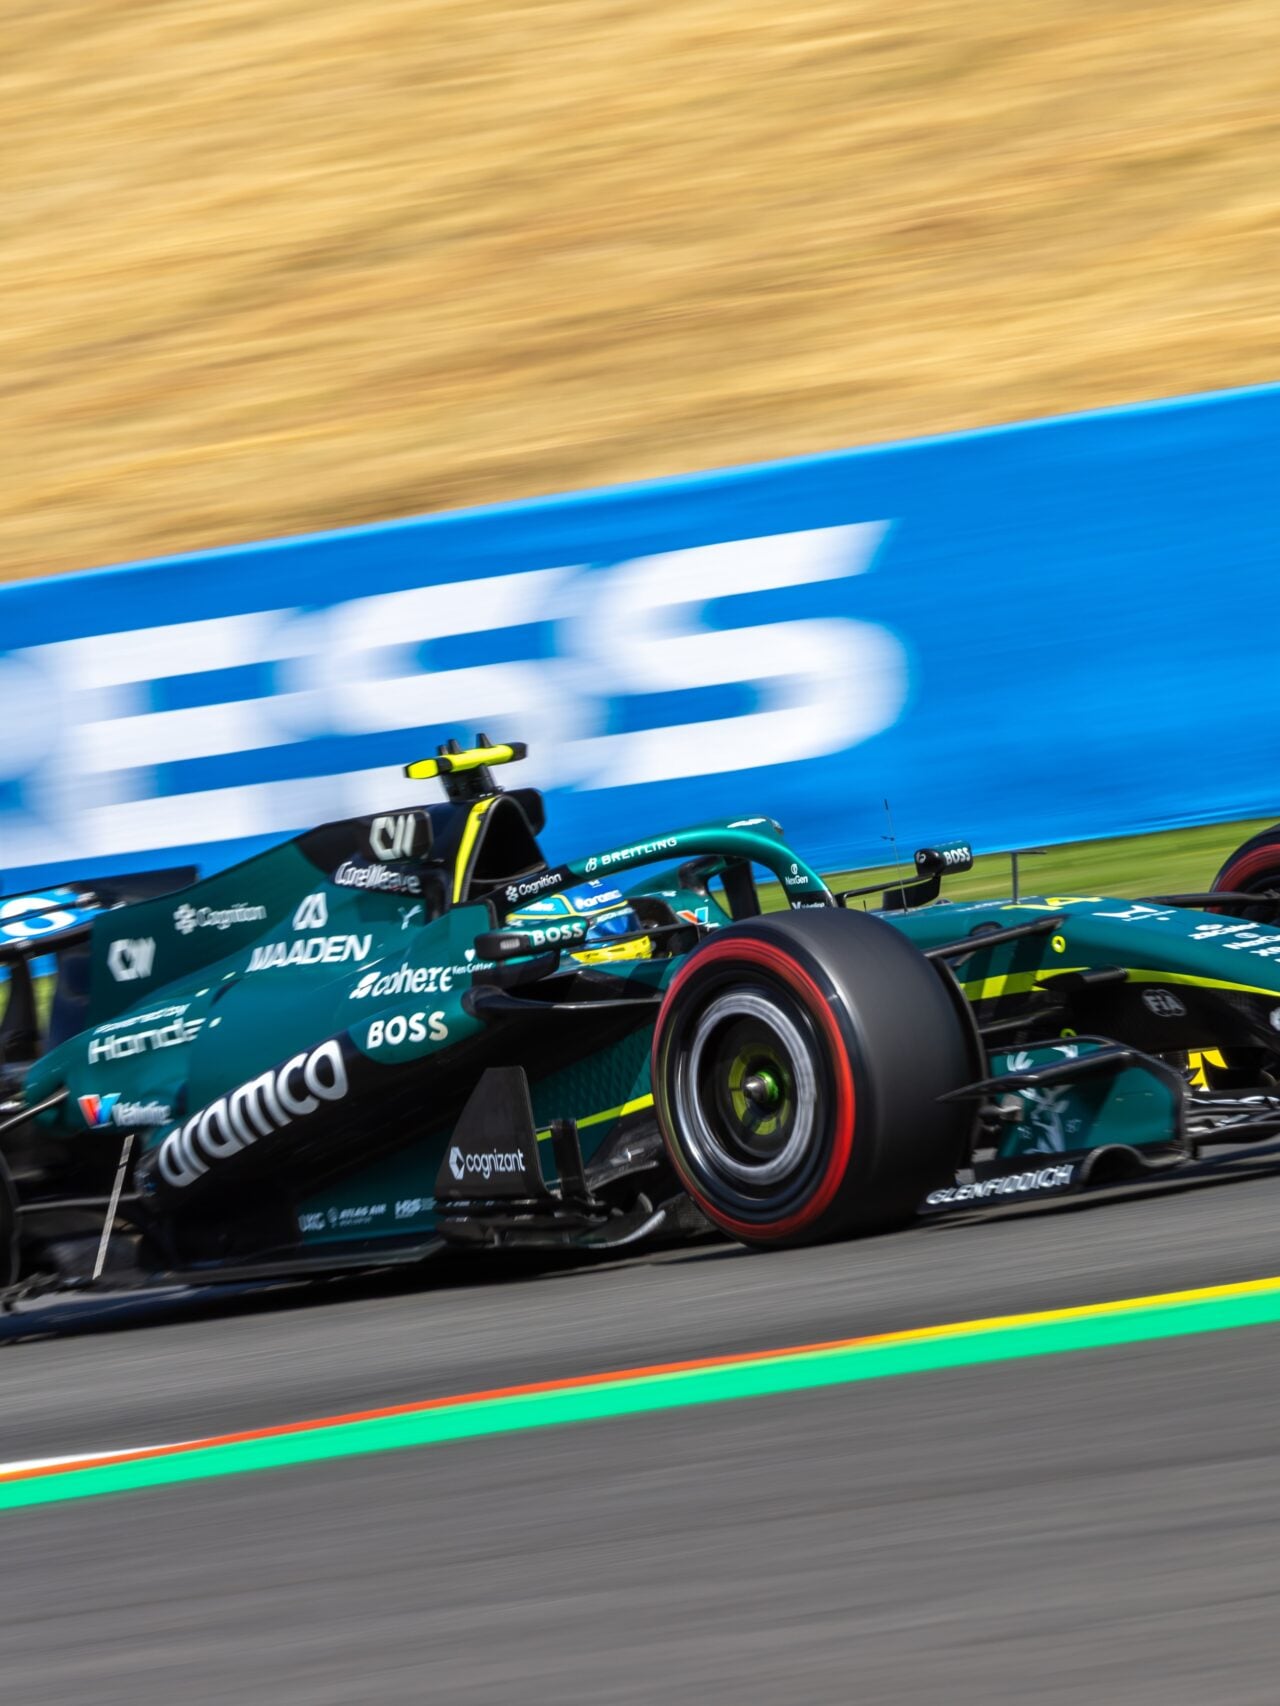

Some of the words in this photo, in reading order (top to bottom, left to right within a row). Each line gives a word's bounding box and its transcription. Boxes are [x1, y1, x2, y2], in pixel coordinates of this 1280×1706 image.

[602, 837, 677, 865] BREITLING
[943, 847, 971, 866] BOSS
[334, 861, 423, 894] CoreWeave
[519, 873, 563, 895] Cognition
[530, 922, 584, 947] BOSS
[371, 962, 453, 997] cohere
[88, 1017, 206, 1064] Honda
[366, 1010, 449, 1049] BOSS
[158, 1039, 349, 1188] aramco
[466, 1148, 525, 1179] cognizant
